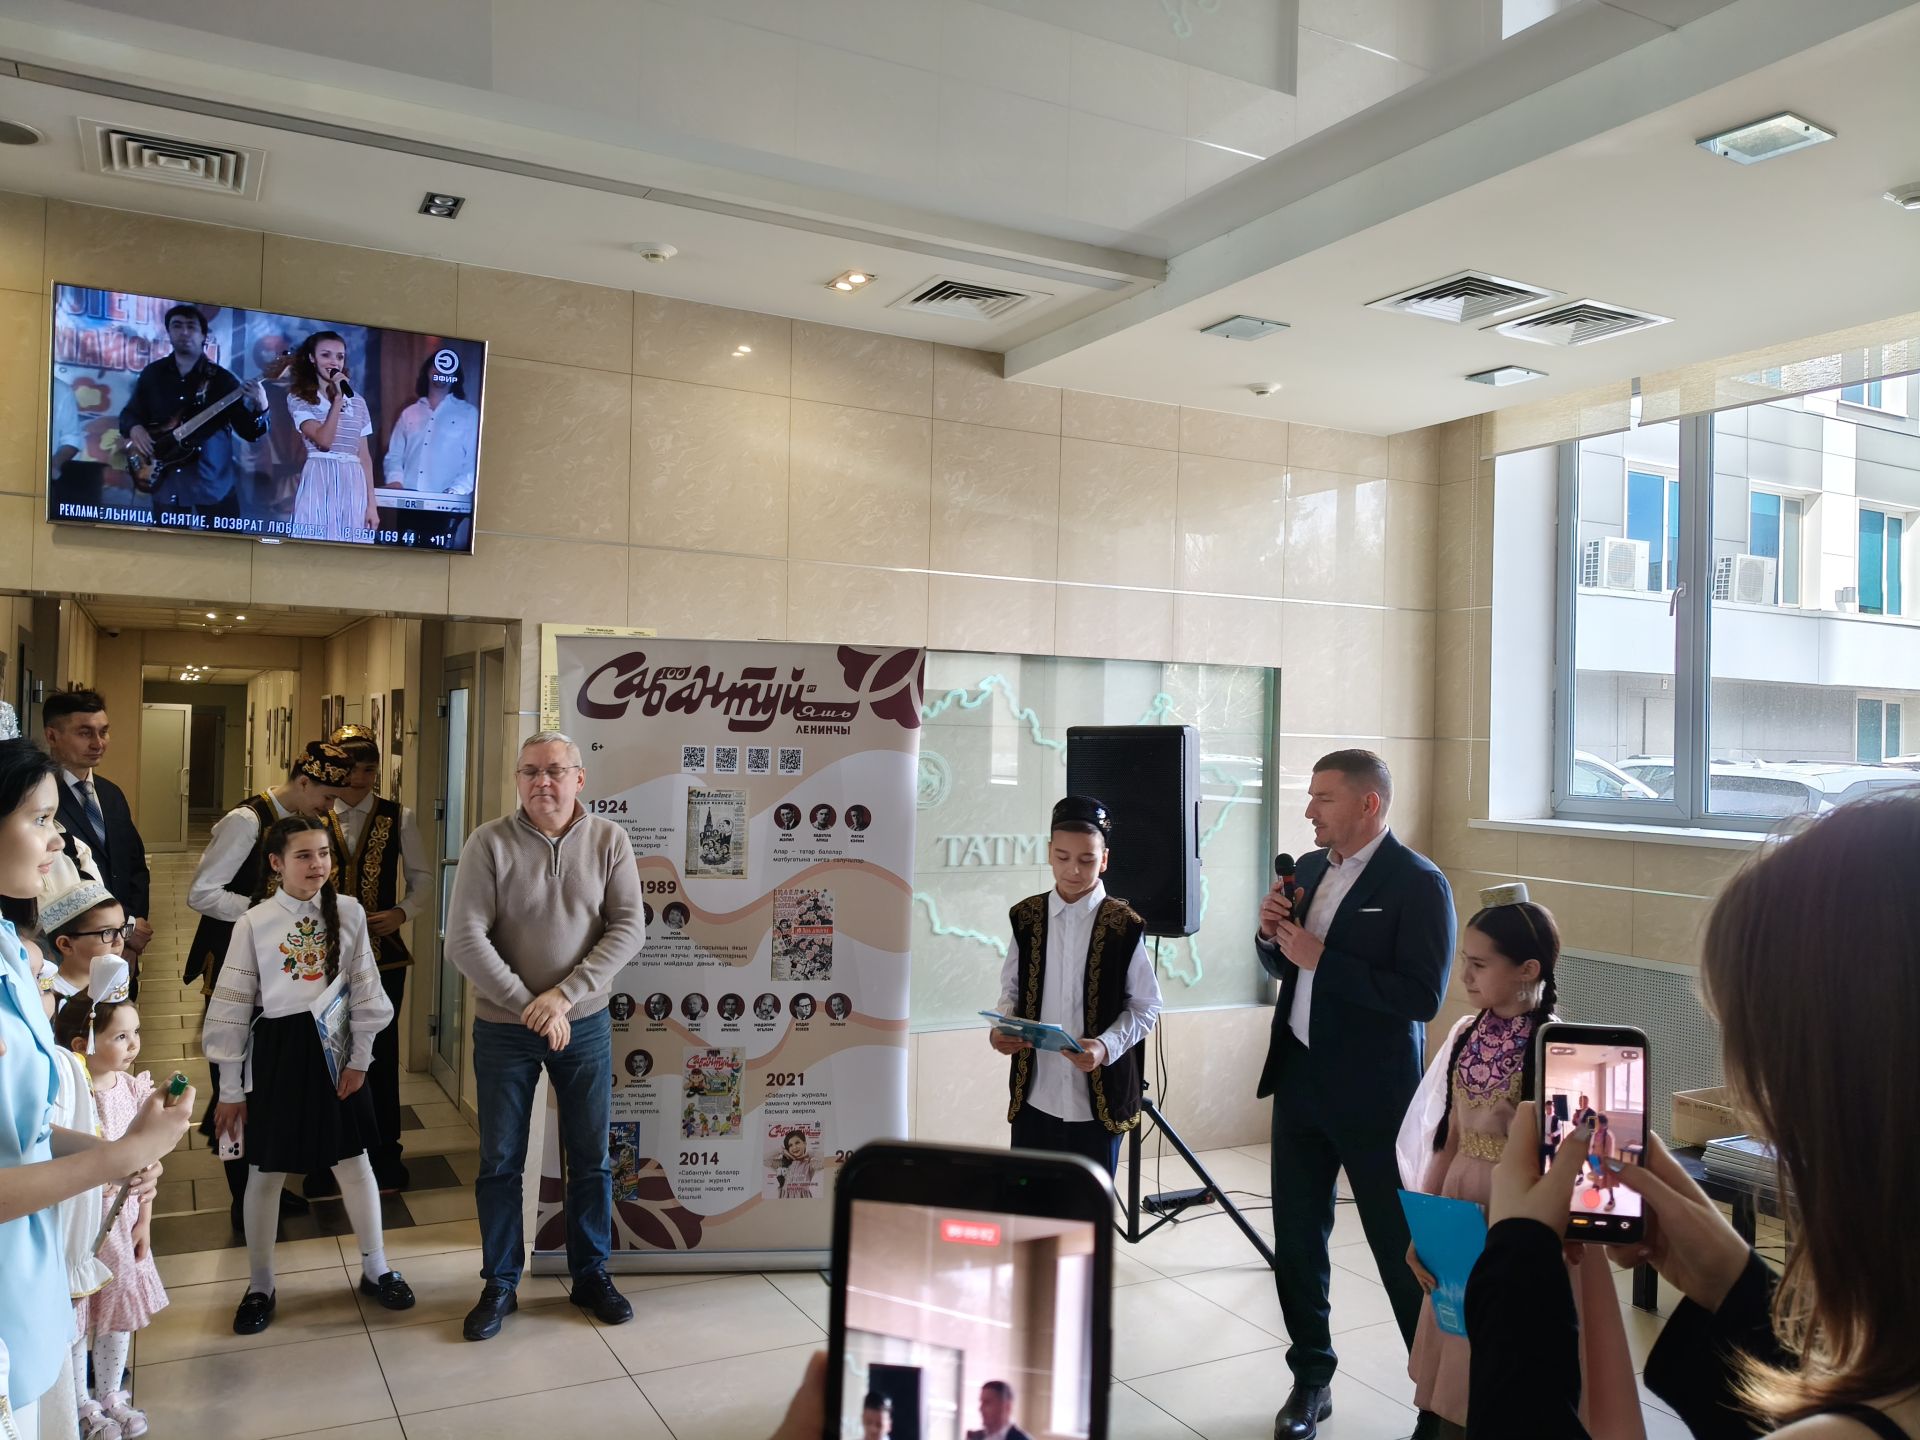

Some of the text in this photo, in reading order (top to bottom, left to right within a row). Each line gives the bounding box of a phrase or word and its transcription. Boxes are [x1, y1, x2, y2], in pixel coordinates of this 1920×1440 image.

[432, 374, 458, 384] ЭФИР
[60, 503, 98, 519] РЕКЛАМА
[214, 516, 264, 532] ВОЗВРАТ
[268, 520, 325, 537] ЛЮБИМЫХ
[355, 528, 375, 541] 960
[380, 530, 398, 543] 169
[402, 532, 415, 544] 44
[658, 668, 686, 680] 100
[577, 652, 859, 732] Сабантуй
[797, 705, 851, 718] Яшь
[796, 725, 850, 735] ЛЕНИНЧЫ
[592, 742, 604, 751] 6+
[588, 800, 628, 814] 1924
[939, 834, 1052, 867] ТАТМ
[641, 880, 676, 894] 1989
[766, 1073, 804, 1086] 2021
[679, 1152, 719, 1166] 2014
[835, 1150, 852, 1164] 20
